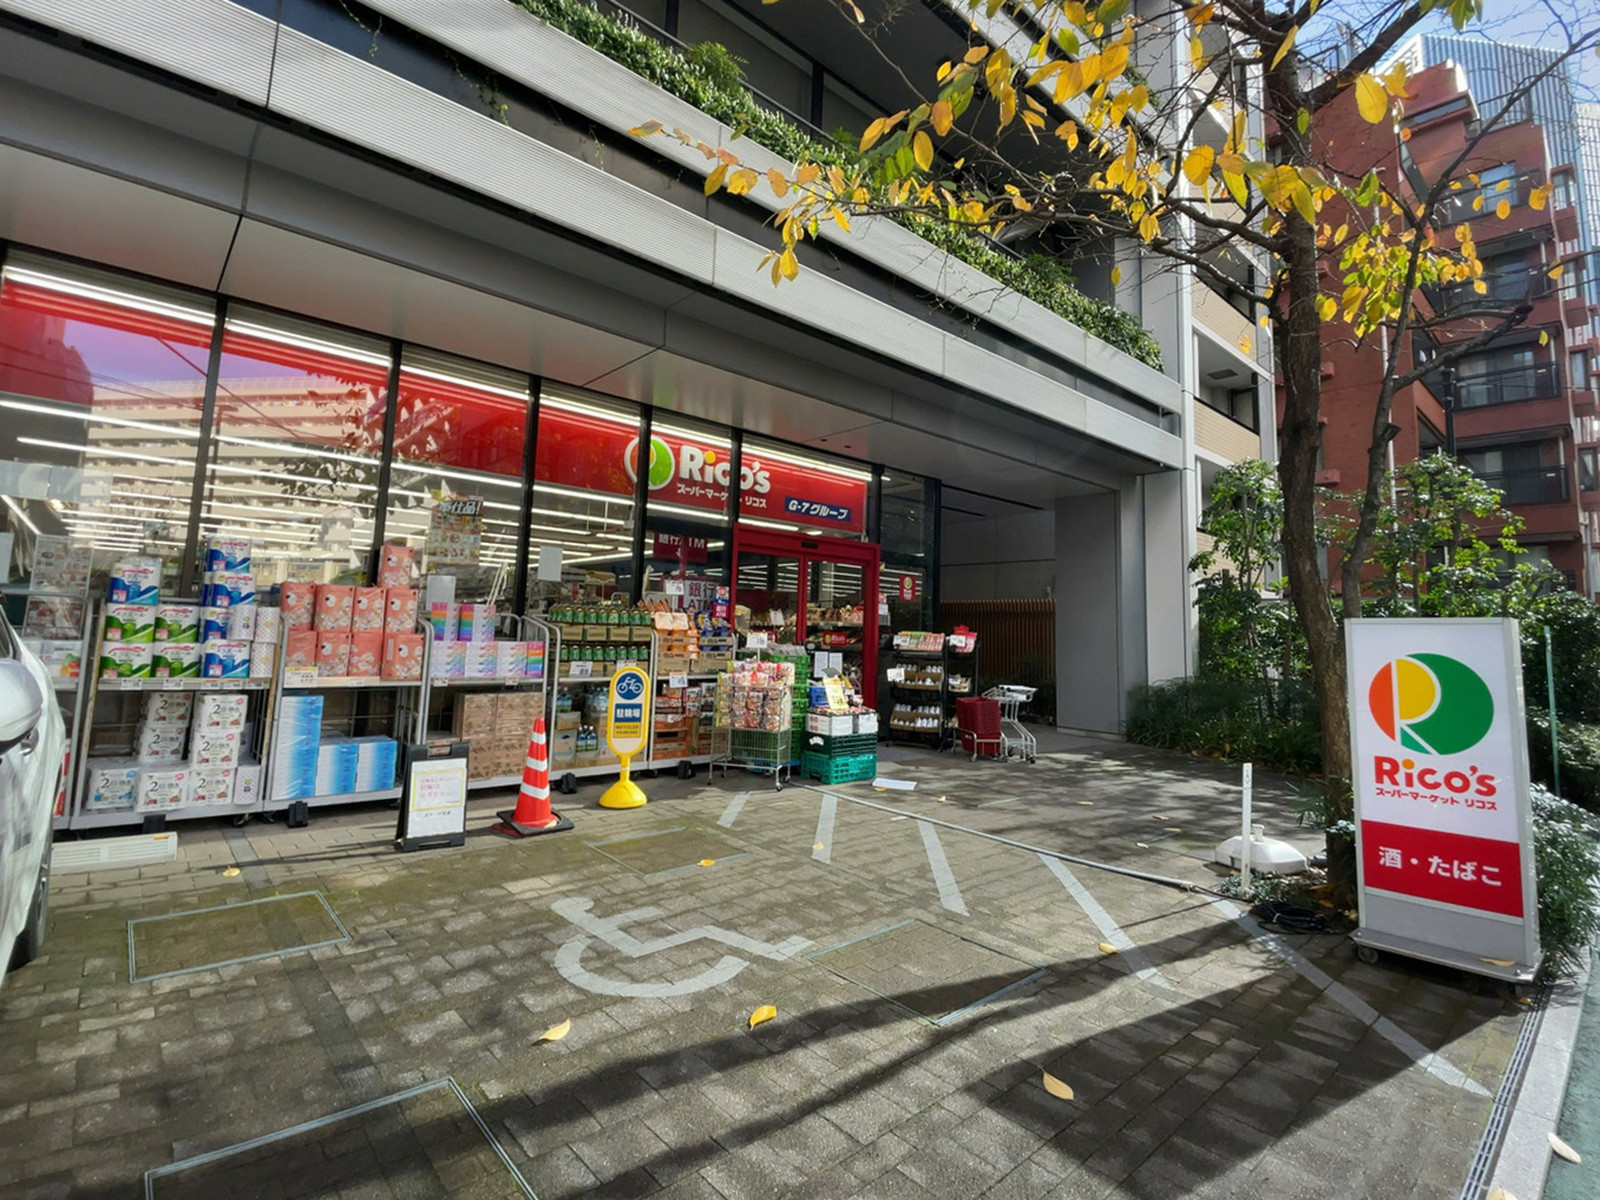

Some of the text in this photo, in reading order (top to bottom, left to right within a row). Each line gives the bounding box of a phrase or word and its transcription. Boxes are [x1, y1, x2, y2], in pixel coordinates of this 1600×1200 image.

[679, 444, 771, 494] Rico's
[677, 483, 767, 509] スーパーマーケ リコス
[1374, 755, 1497, 797] Rico's
[1375, 786, 1498, 811] スーパーマーケット リコス
[1378, 845, 1502, 887] 酒・たばこ
